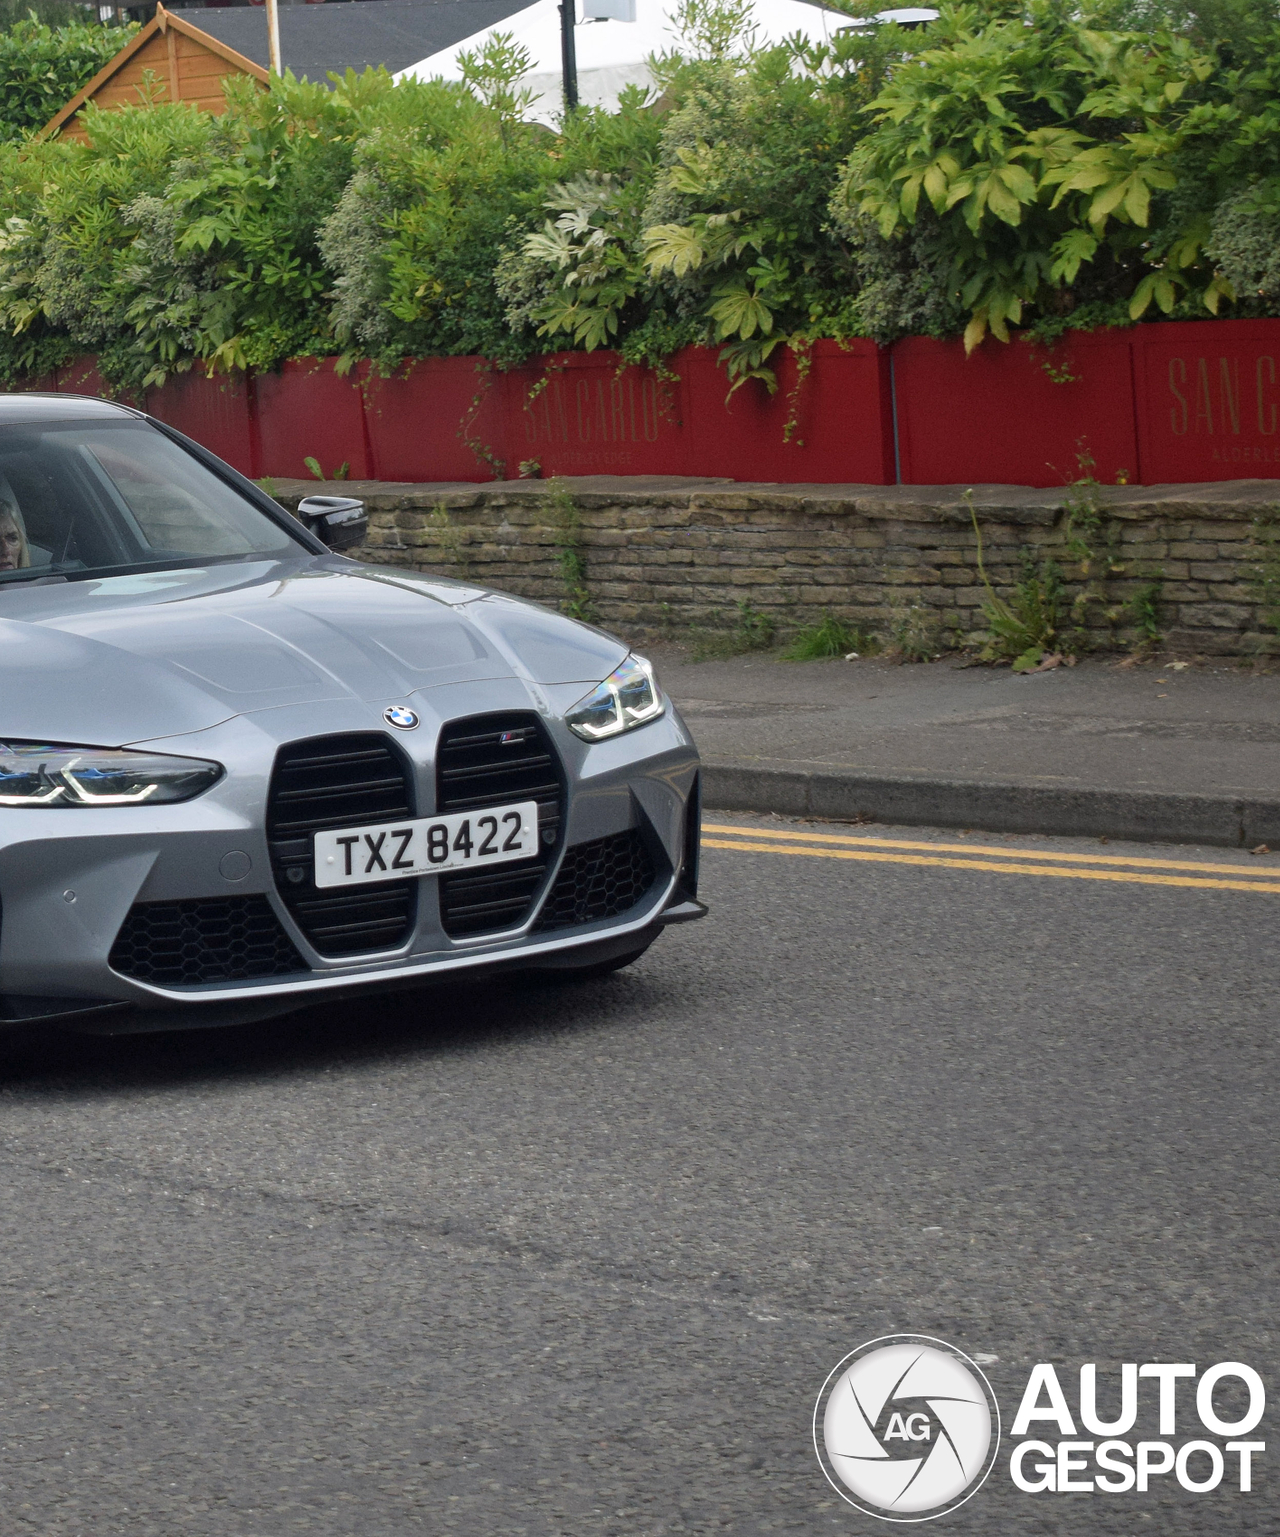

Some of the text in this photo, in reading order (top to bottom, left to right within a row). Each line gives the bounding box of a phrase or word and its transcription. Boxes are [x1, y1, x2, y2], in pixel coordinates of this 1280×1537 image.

[576, 377, 658, 442] CARLO
[1169, 357, 1240, 434] SAN
[1212, 447, 1280, 462] ALDERLE
[336, 811, 522, 875] TXZ 8422
